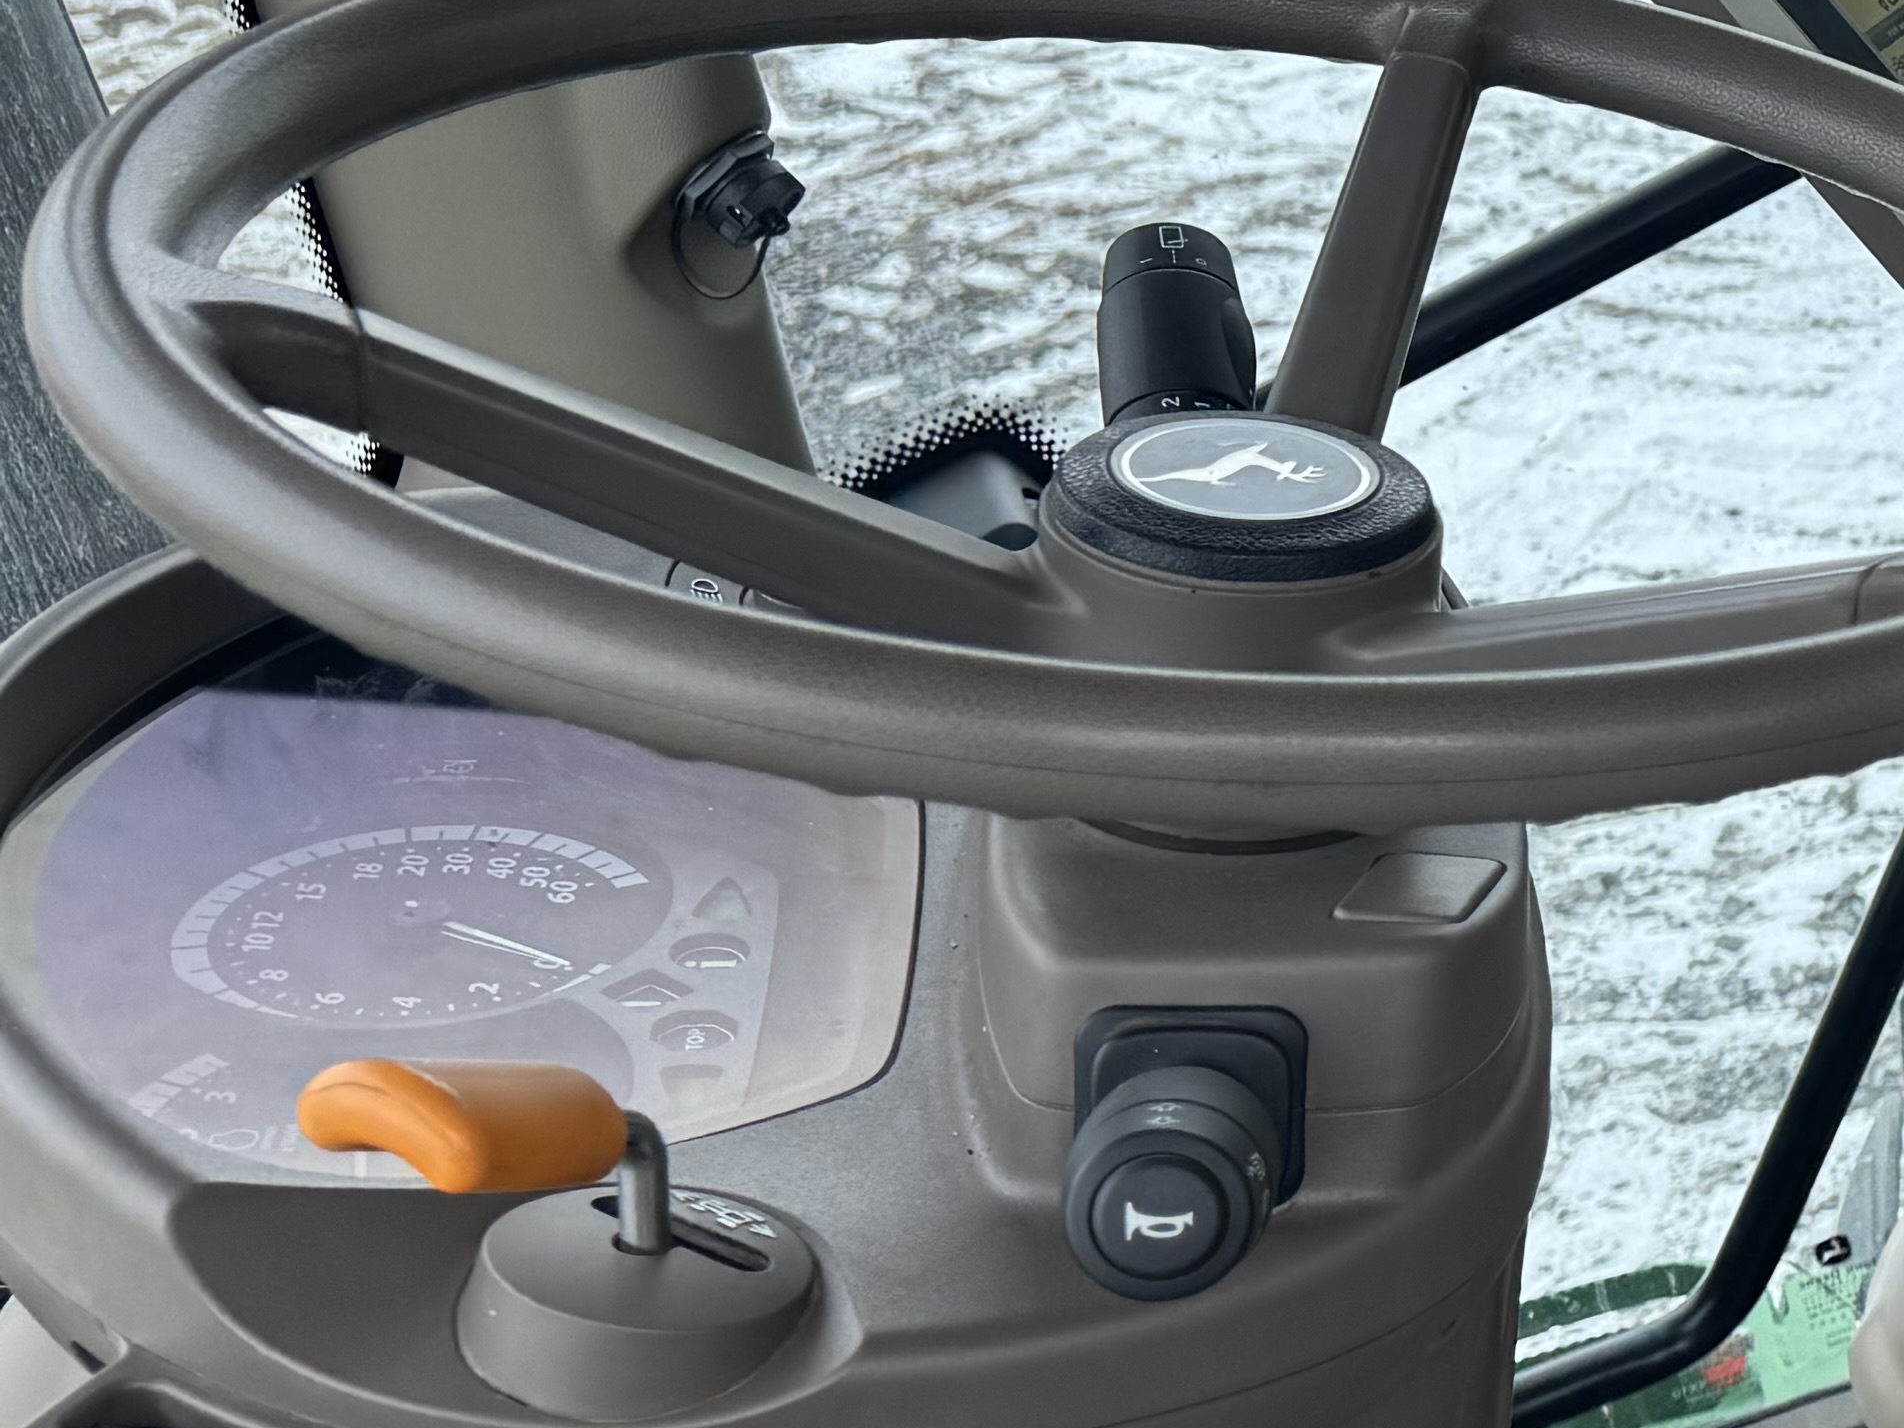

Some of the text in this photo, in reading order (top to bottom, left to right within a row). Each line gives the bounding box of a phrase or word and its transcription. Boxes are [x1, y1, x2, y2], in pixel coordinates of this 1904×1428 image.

[1161, 396, 1180, 408] 2
[353, 861, 384, 881] 18
[397, 854, 429, 877] 20
[443, 853, 474, 875] 30
[486, 857, 517, 880] 40
[519, 866, 551, 890] 50
[296, 882, 327, 903] 15
[547, 879, 579, 904] 60
[253, 909, 284, 930] 12
[242, 931, 275, 953] 10
[258, 968, 289, 983] 8
[315, 990, 346, 1006] 6
[468, 981, 499, 999] 2
[393, 994, 422, 1010] 4
[204, 1090, 237, 1104] 3
